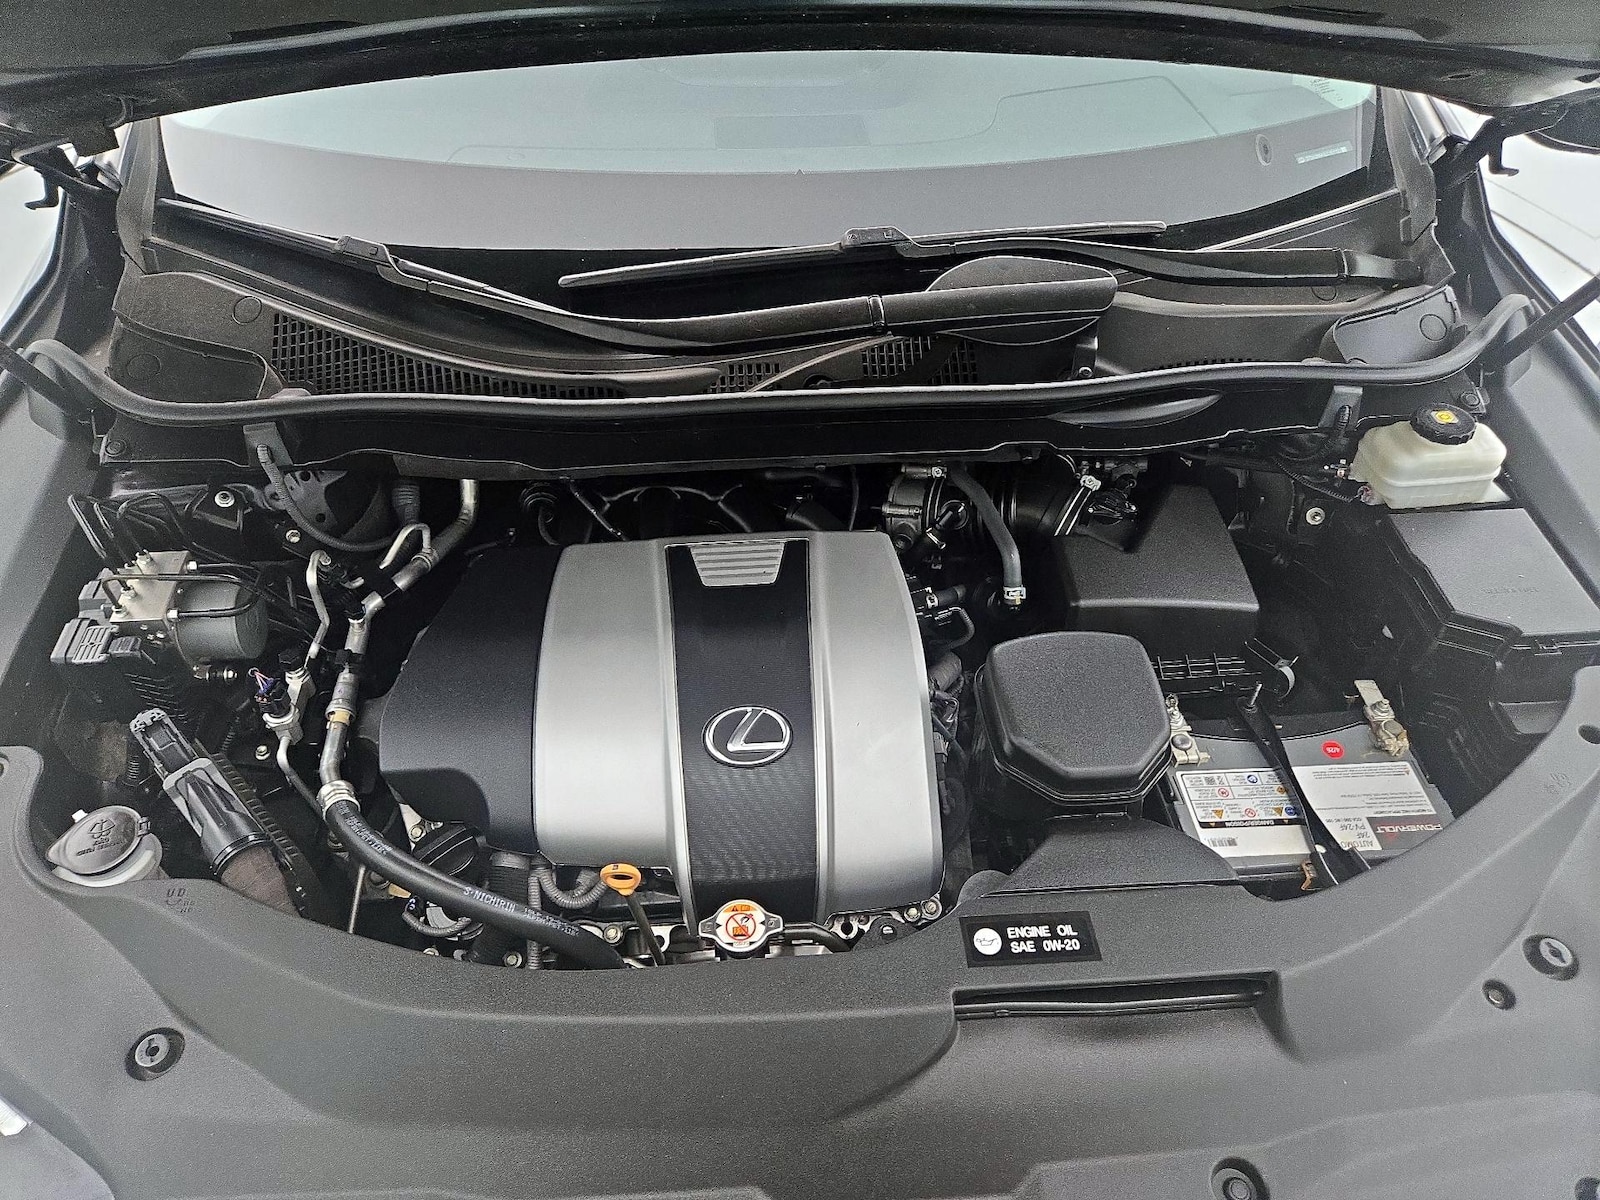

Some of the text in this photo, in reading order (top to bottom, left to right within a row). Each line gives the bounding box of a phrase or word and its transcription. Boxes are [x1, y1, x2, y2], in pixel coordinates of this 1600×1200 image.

[1375, 823, 1443, 833] POWERVOLT
[1006, 924, 1078, 939] ENGINE OIL
[1010, 938, 1081, 954] SAE 0W-20
